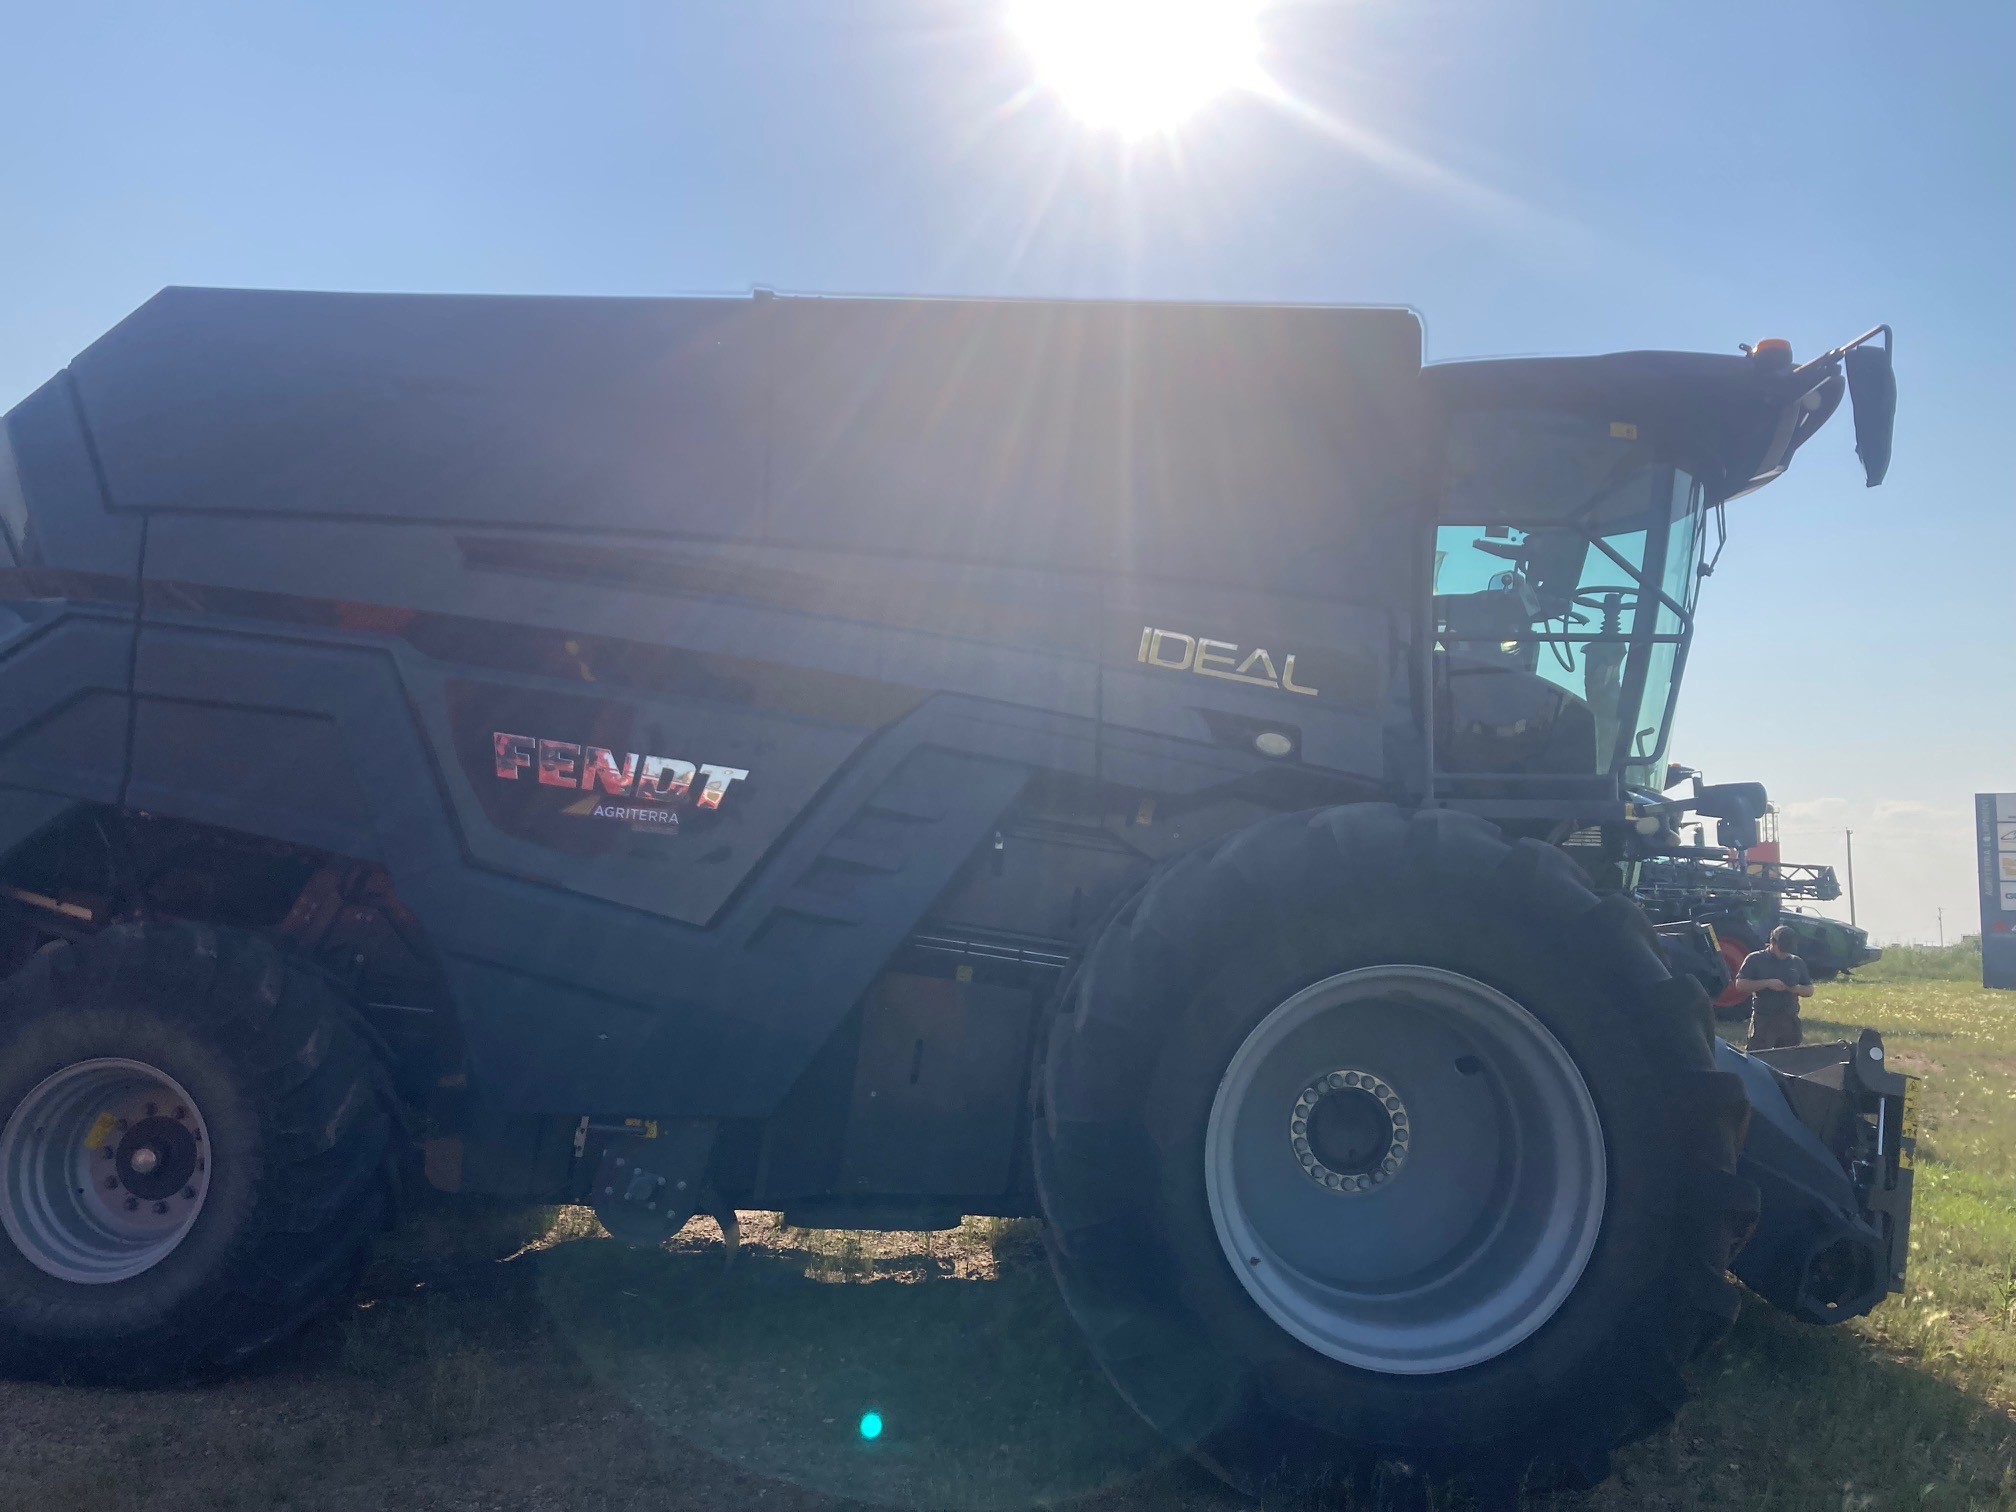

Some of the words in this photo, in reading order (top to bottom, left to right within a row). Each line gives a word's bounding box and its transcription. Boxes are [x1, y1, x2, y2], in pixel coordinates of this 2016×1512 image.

[1137, 626, 1319, 696] IDEAL
[493, 731, 750, 810] FENDT
[593, 805, 680, 825] AGRITERRA
